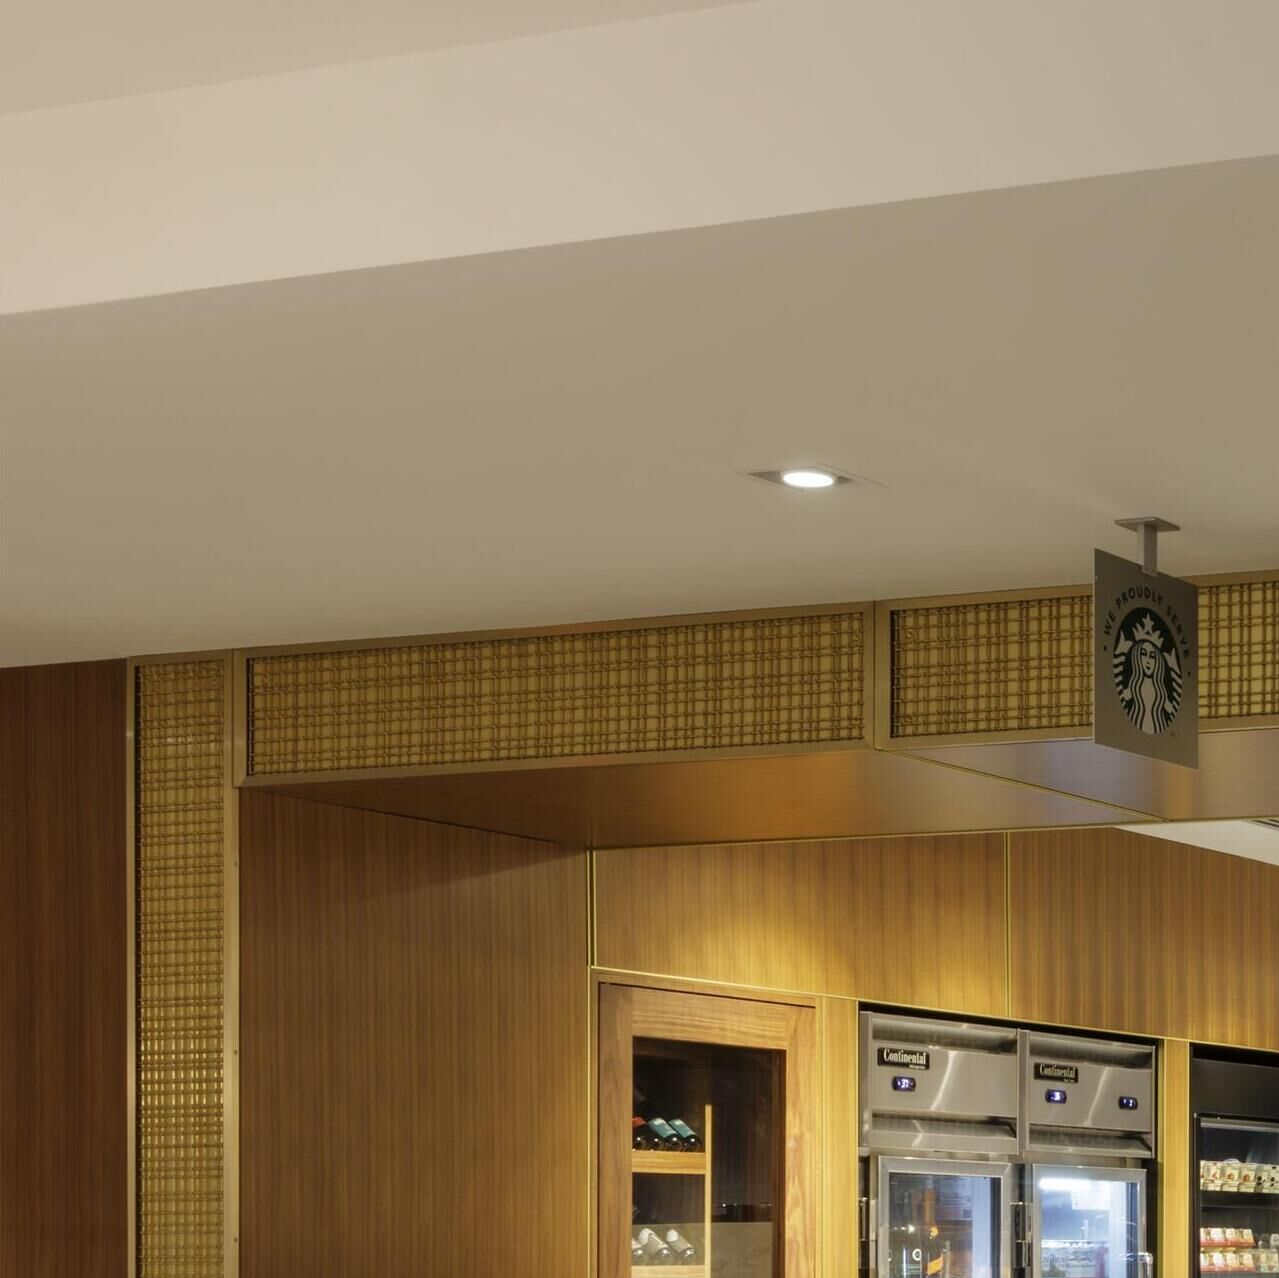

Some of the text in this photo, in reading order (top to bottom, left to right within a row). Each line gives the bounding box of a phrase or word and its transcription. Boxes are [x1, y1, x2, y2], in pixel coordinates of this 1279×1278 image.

[1115, 585, 1163, 610] PROUDLY
[883, 1048, 926, 1065] Continental
[1040, 1063, 1076, 1078] Continental
